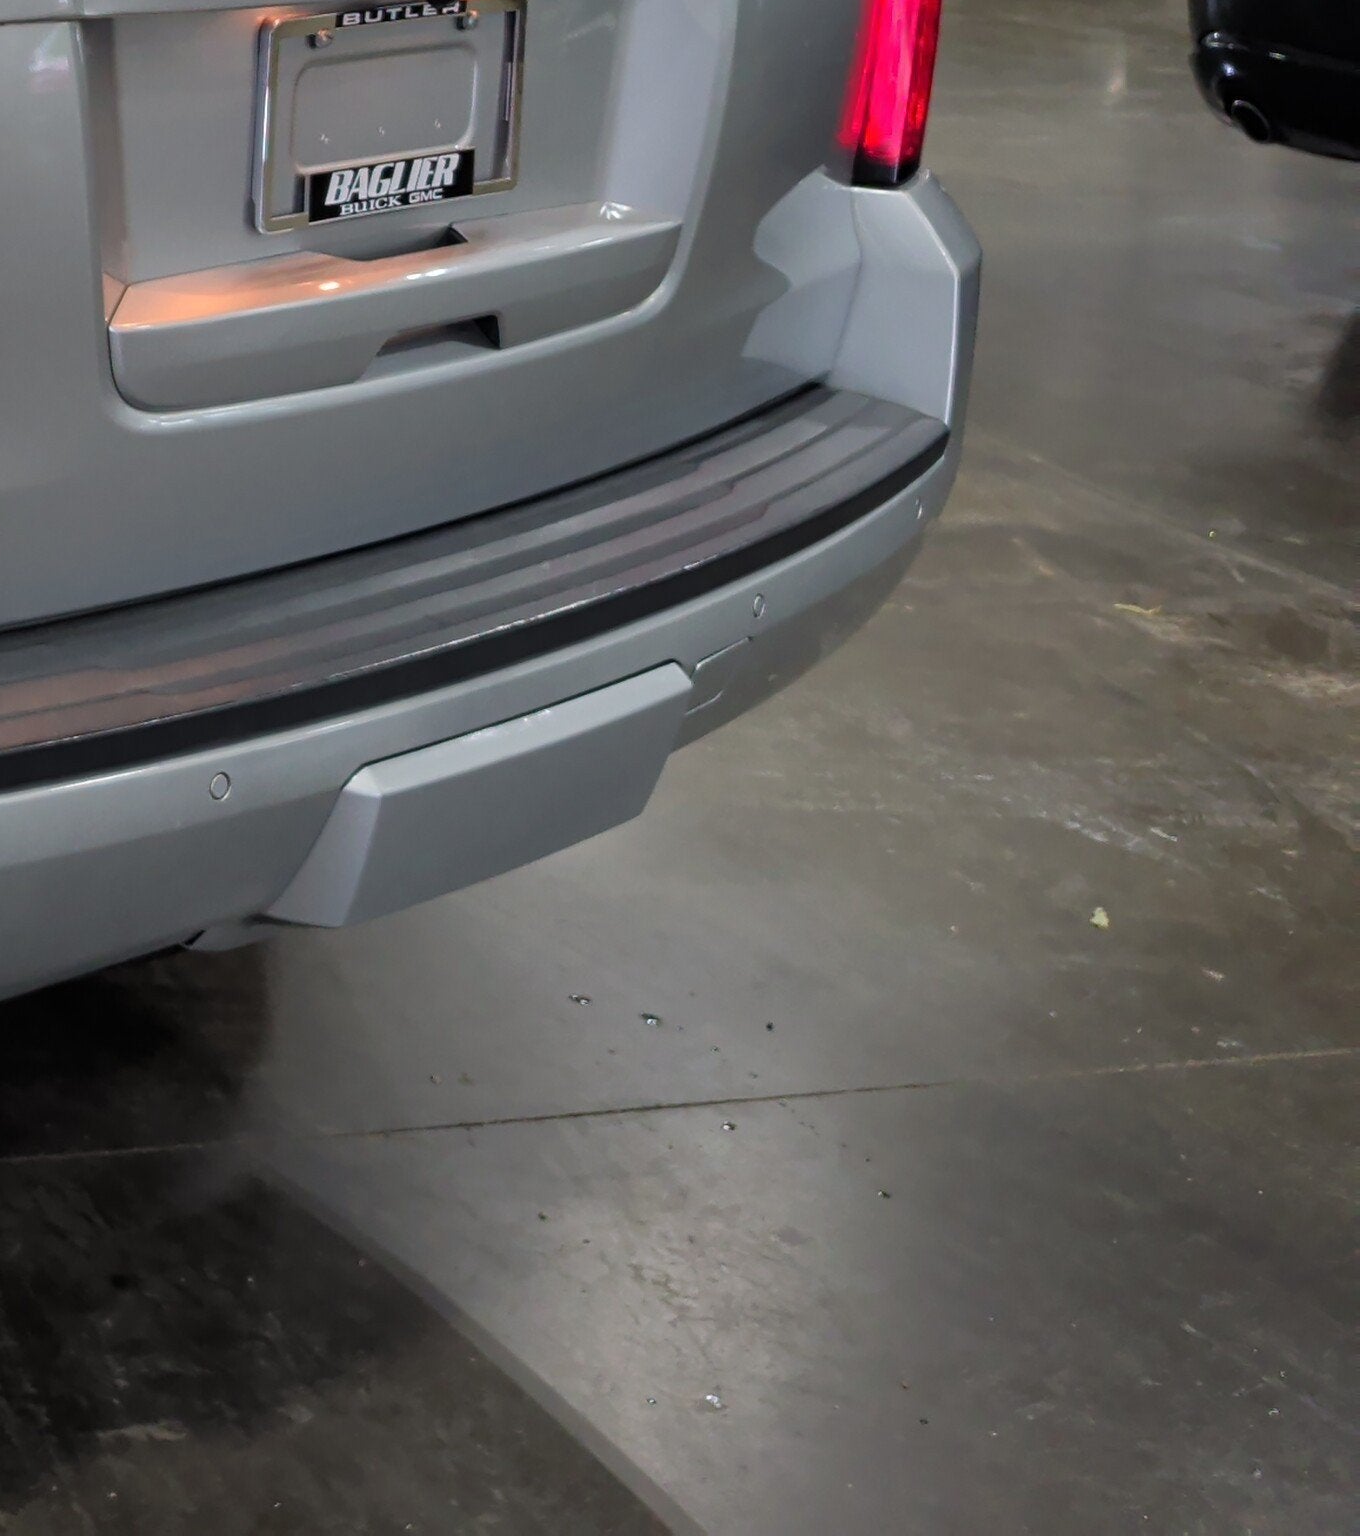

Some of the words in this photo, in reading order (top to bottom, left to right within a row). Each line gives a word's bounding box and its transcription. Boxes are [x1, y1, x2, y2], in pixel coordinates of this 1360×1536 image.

[324, 153, 460, 206] BAGLIER
[340, 195, 402, 216] BUICK
[408, 188, 444, 204] GMC
